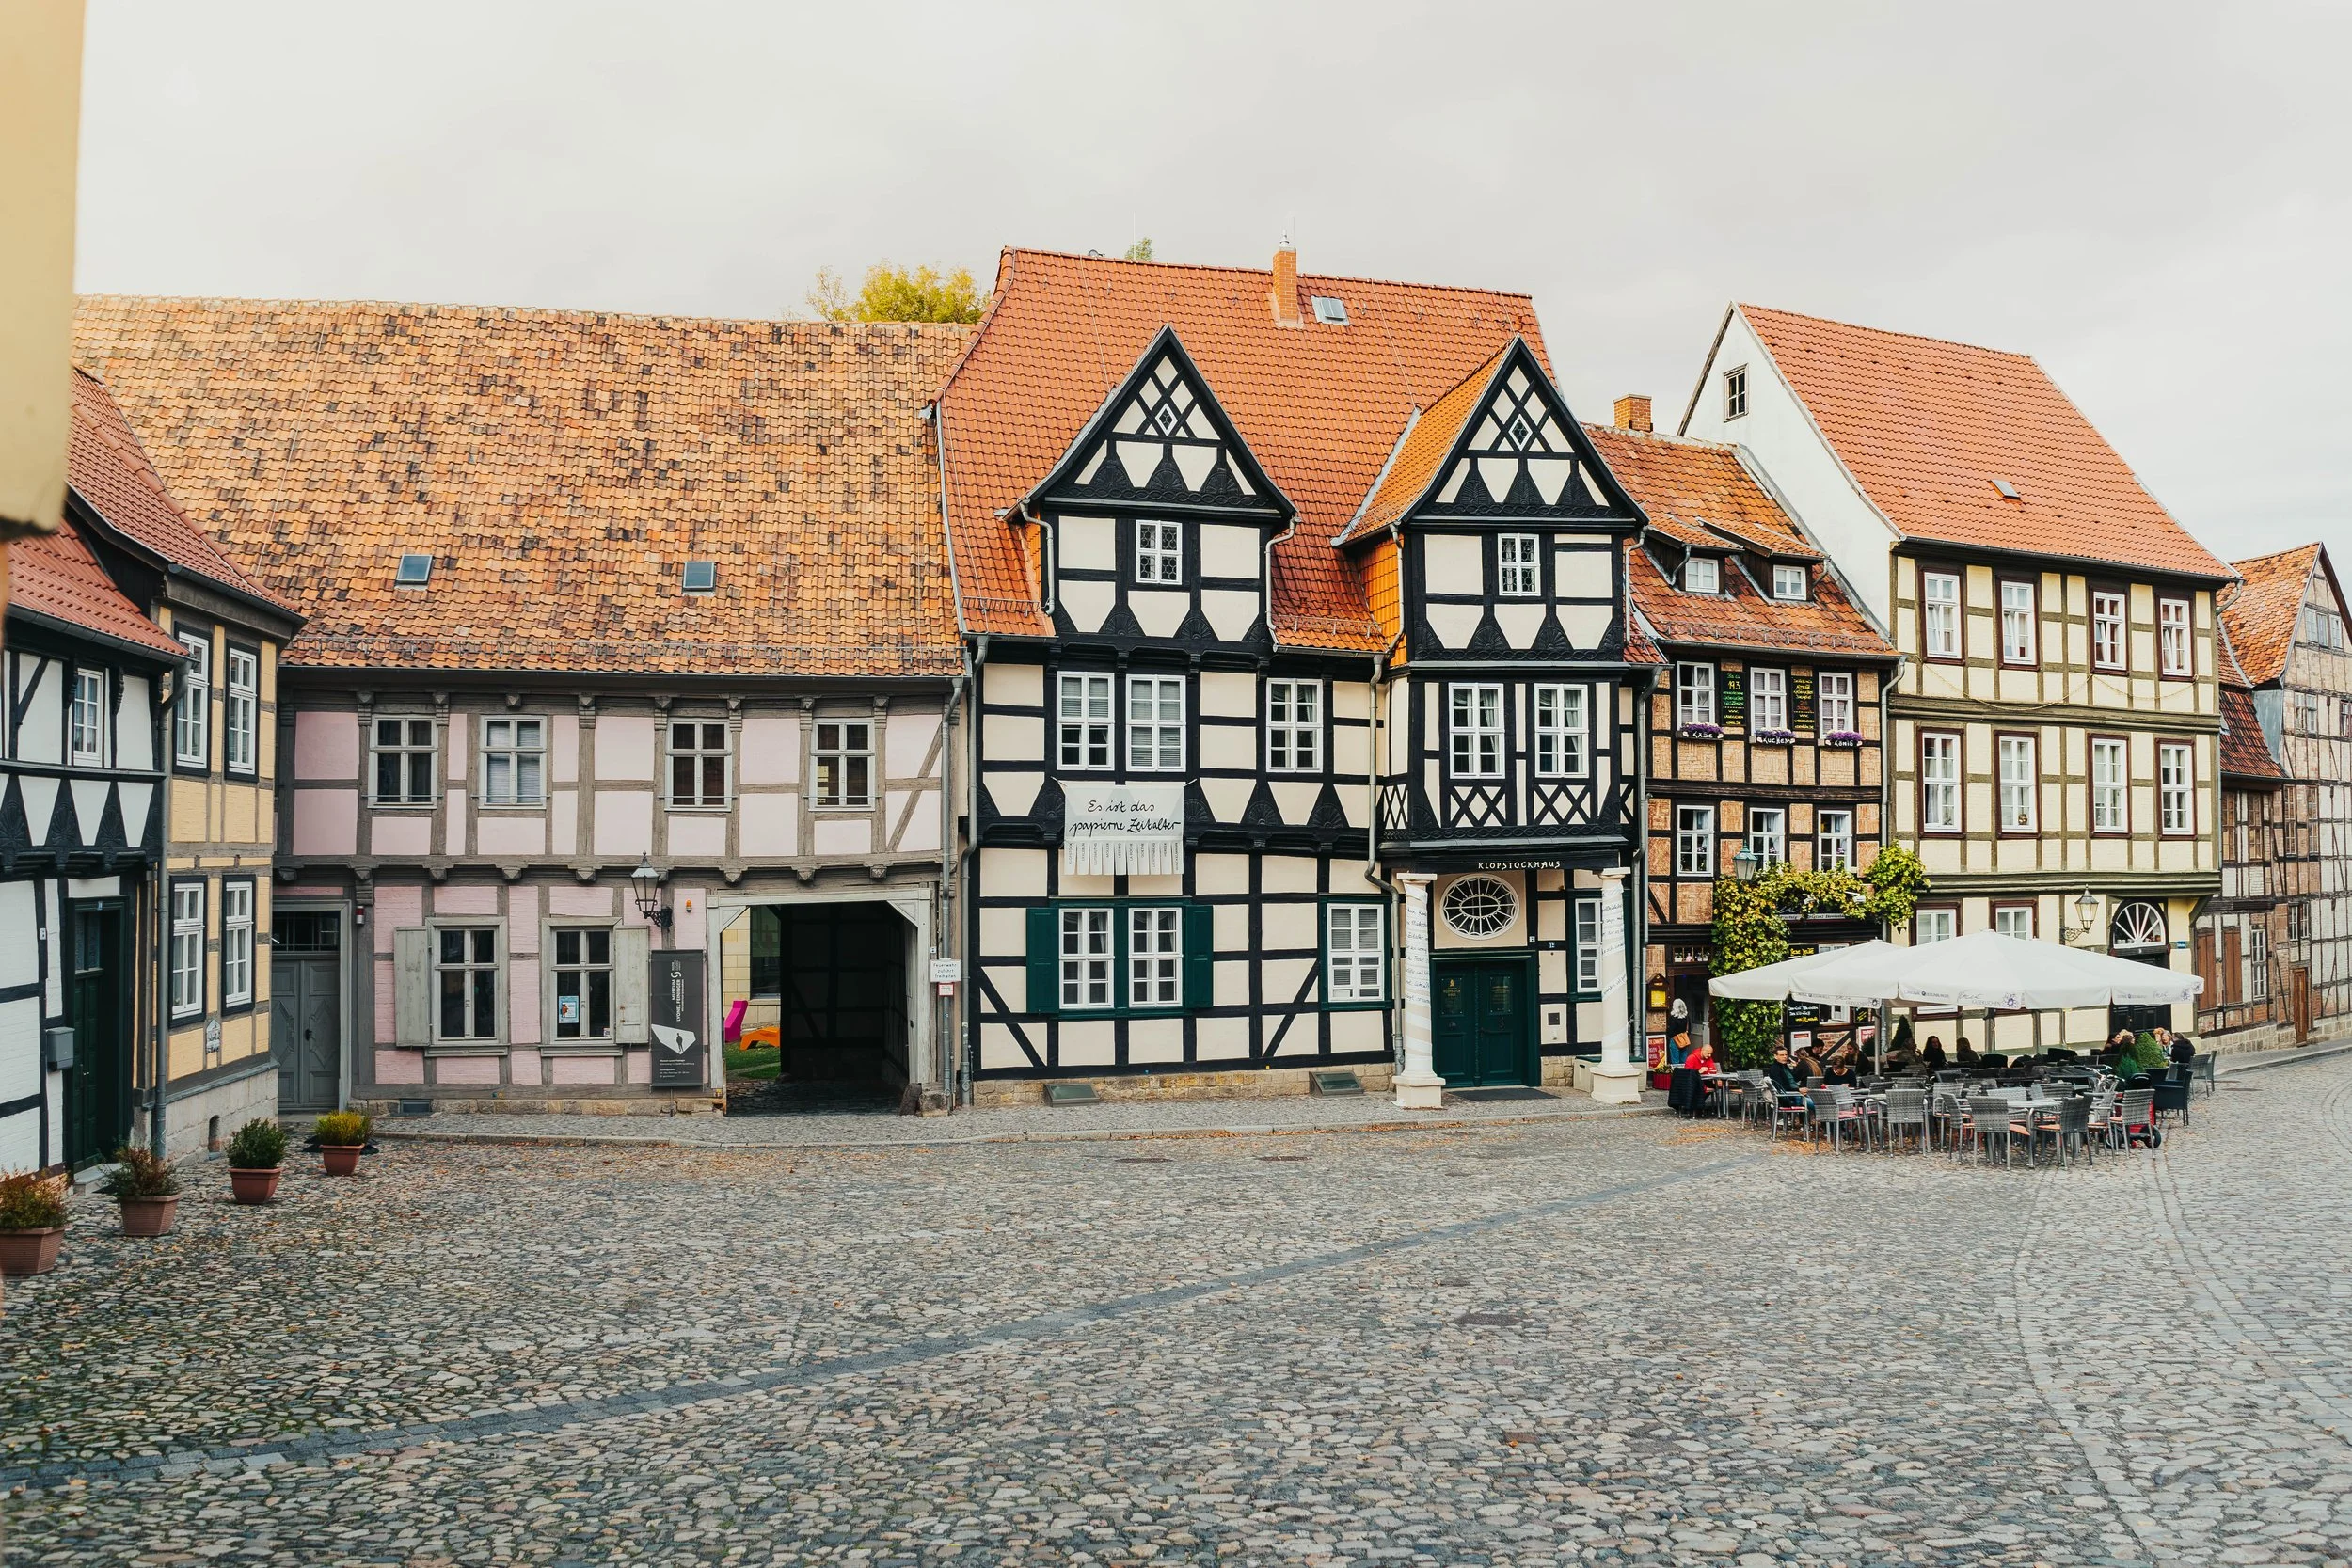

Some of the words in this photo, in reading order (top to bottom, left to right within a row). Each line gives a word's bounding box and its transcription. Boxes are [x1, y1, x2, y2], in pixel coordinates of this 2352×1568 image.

[1087, 800, 1103, 813] Es
[1106, 800, 1127, 813] ist
[1130, 800, 1155, 813] das
[1069, 818, 1125, 837] papierne
[1127, 818, 1181, 833] Zeitalter
[1478, 861, 1561, 871] KLOPSTOCKHAUS
